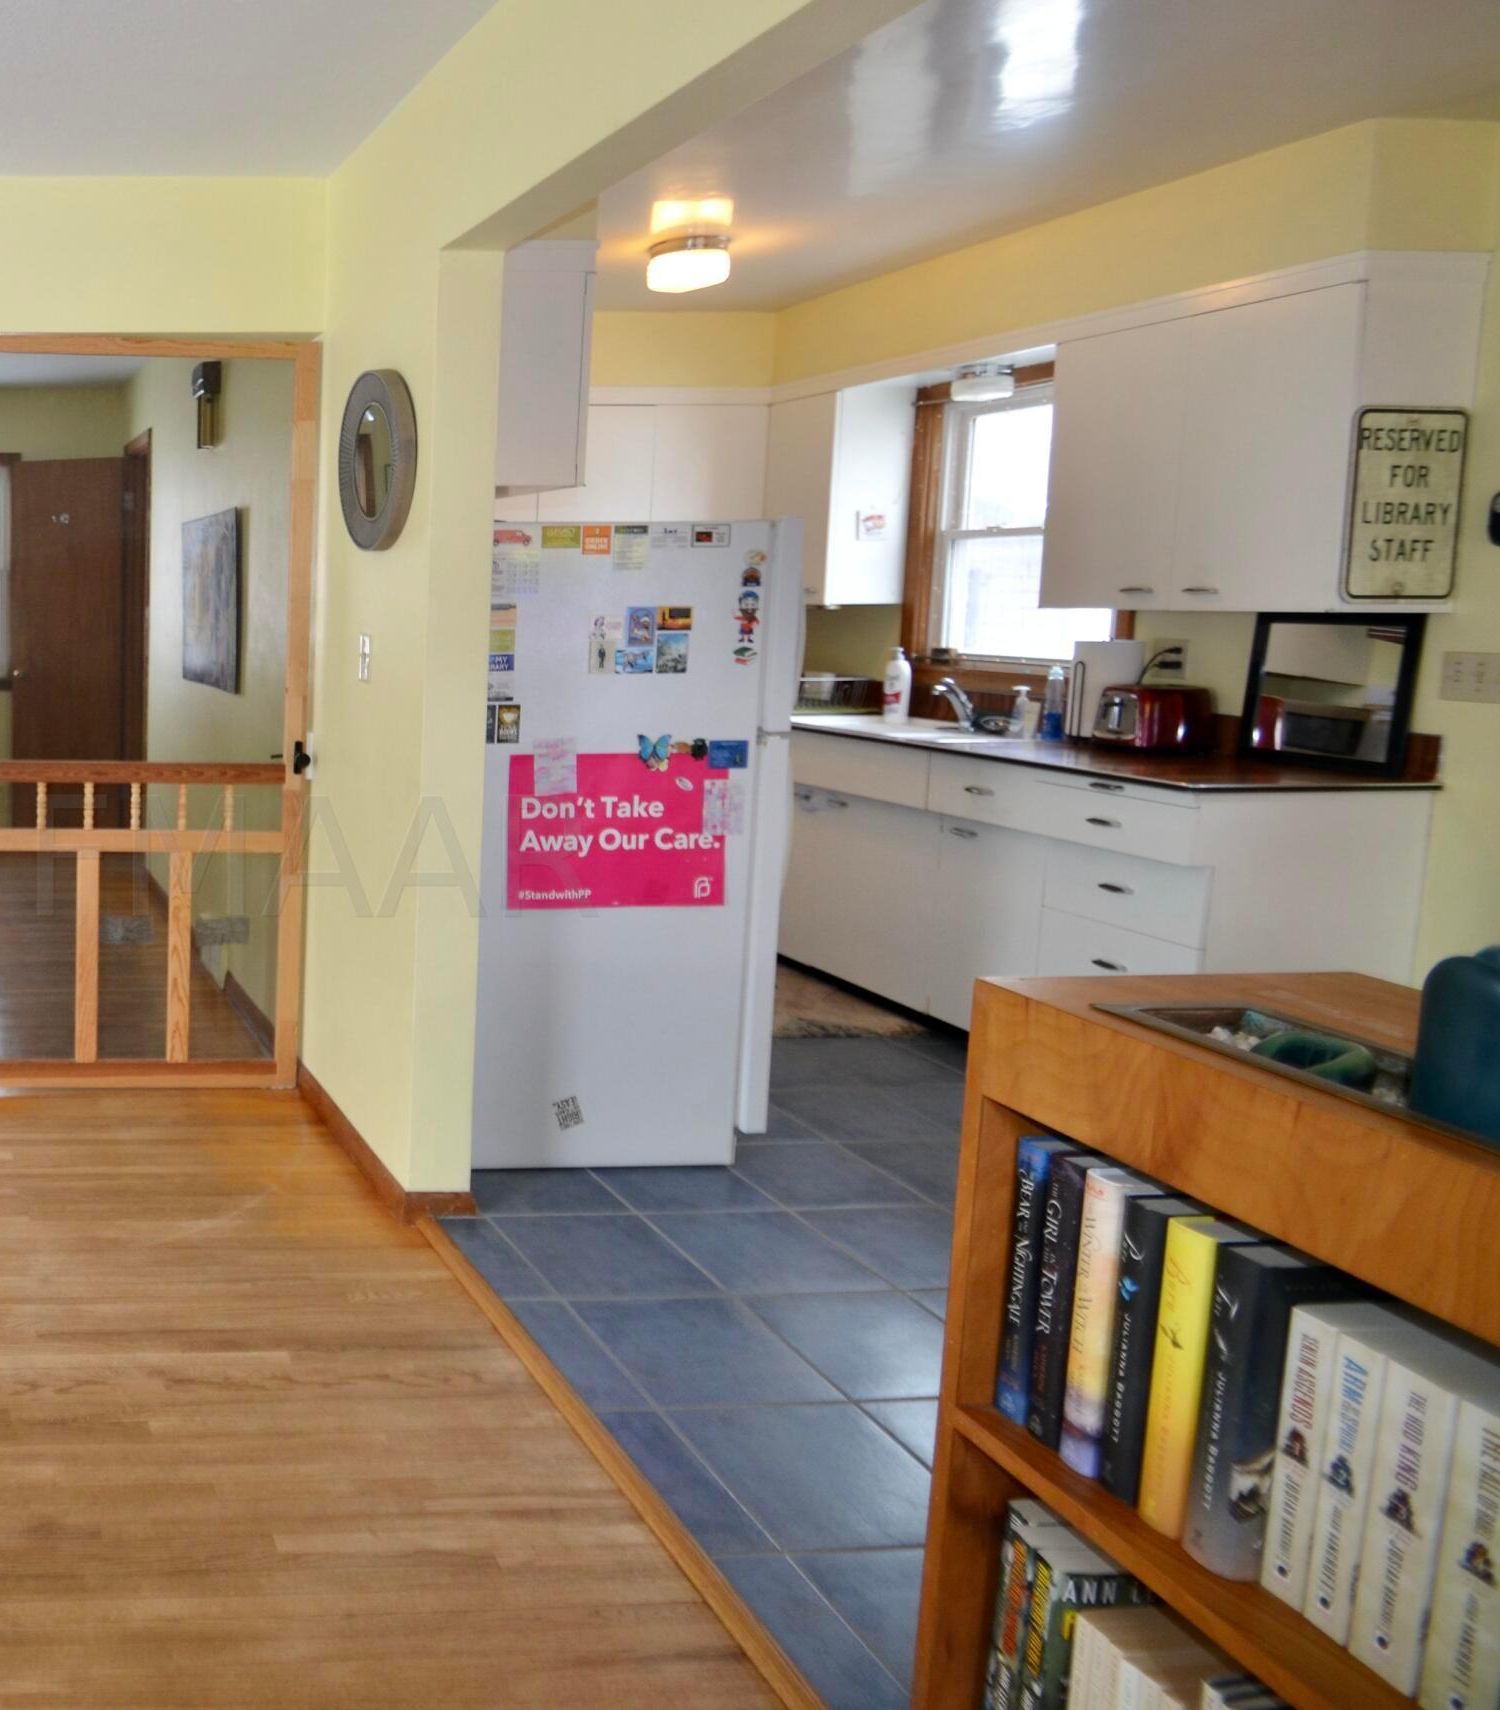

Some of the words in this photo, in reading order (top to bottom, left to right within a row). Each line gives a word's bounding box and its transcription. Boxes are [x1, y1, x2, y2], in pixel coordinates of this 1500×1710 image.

[1360, 427, 1462, 453] RESERVED
[1389, 465, 1430, 488] FOR
[1361, 501, 1452, 525] LIBRARY
[1368, 538, 1435, 562] STAFF
[520, 795, 595, 819] Don't
[600, 794, 664, 818] Take
[519, 829, 593, 858] Away
[600, 828, 649, 850] Our
[655, 827, 720, 849] Care.
[518, 888, 592, 900] #StandwithPP
[1016, 1176, 1035, 1219] BEAR
[1043, 1200, 1062, 1243] GIRL
[1078, 1217, 1098, 1279] WINTER
[1007, 1235, 1033, 1328] NIGHTINGALE
[1036, 1270, 1059, 1335] TOWER
[1072, 1296, 1093, 1354] WITCH
[1118, 1313, 1132, 1377] JULIANNA
[1289, 1366, 1317, 1430] ASCENDS
[1342, 1355, 1369, 1405] ARM
[1111, 1381, 1125, 1444] BAGGOTT
[1210, 1372, 1228, 1440] JULIANNA
[1407, 1391, 1427, 1415] THE
[1403, 1412, 1425, 1446] HOD
[1203, 1444, 1220, 1511] BAGGOTT
[1395, 1443, 1421, 1492] KING
[1062, 1578, 1117, 1605] ANN
